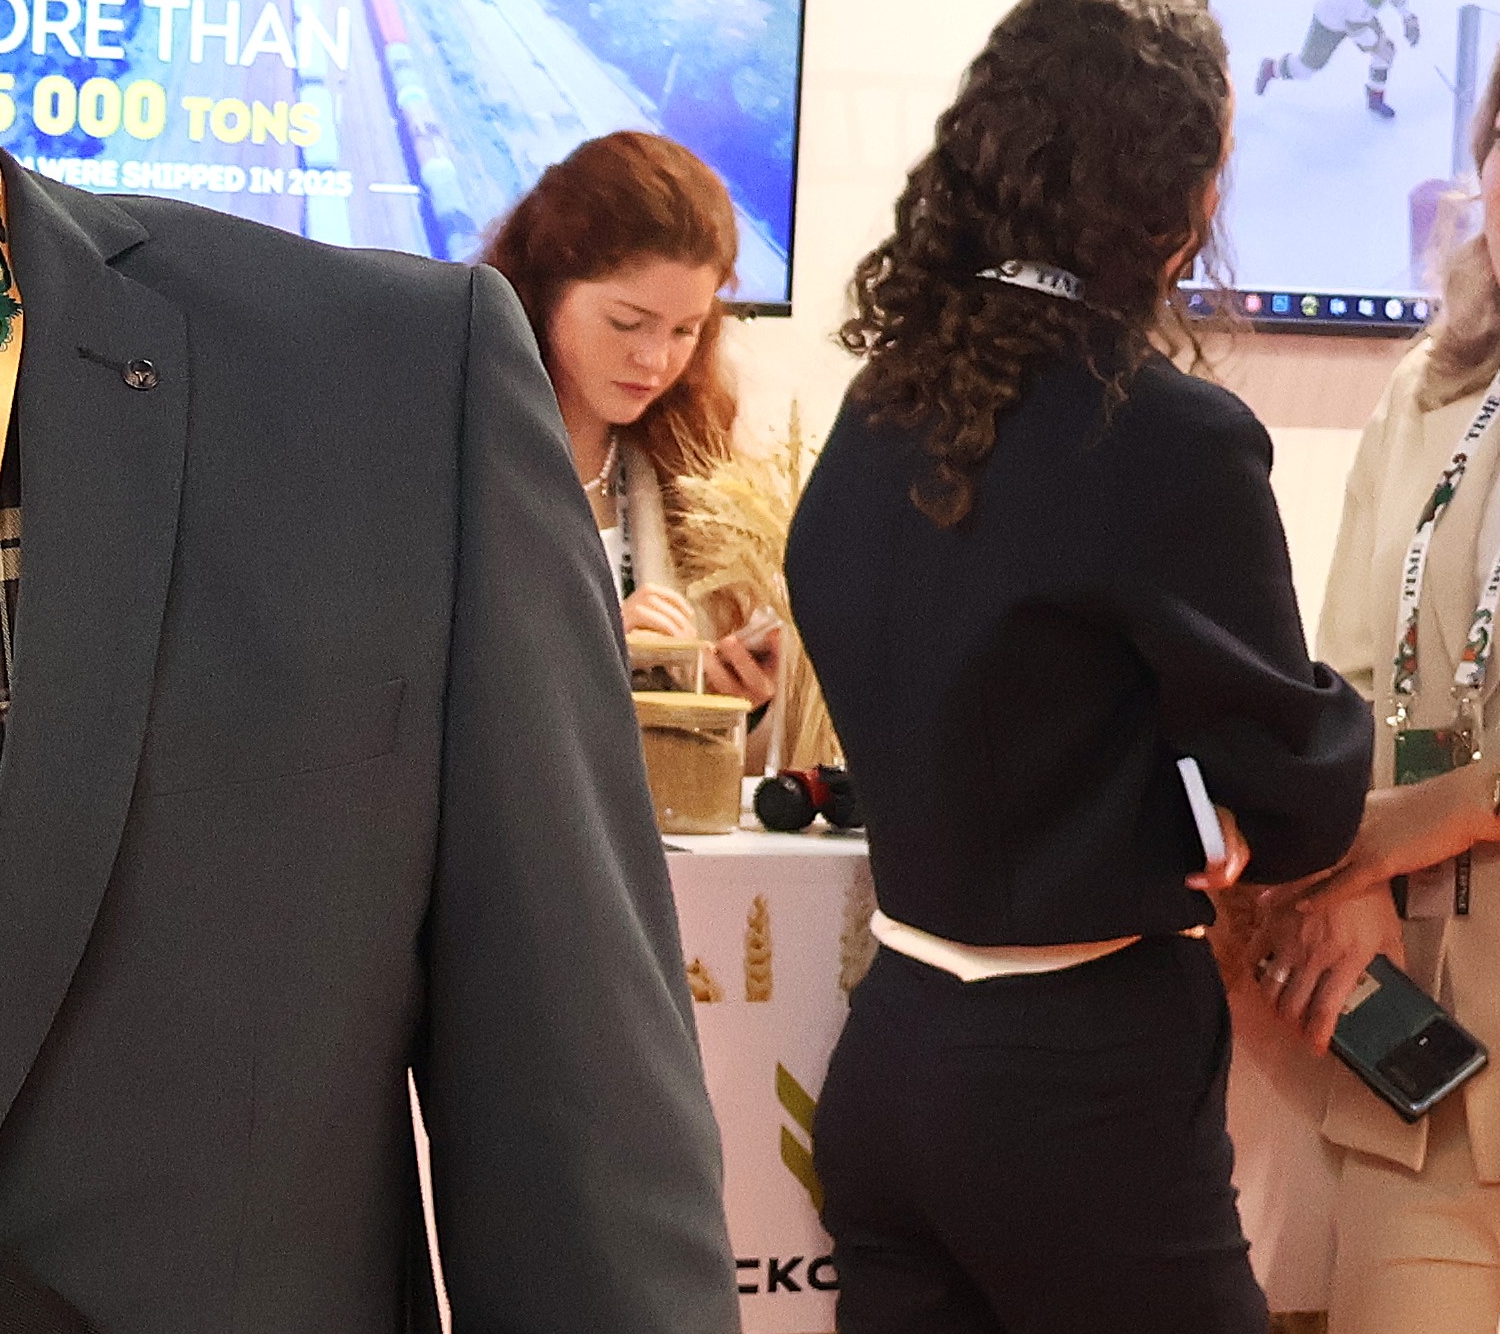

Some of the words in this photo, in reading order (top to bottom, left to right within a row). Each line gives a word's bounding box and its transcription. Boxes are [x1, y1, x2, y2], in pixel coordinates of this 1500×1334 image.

[31, 73, 169, 144] 000
[182, 97, 322, 151] TONS
[37, 155, 119, 187] WERE
[121, 160, 246, 195] SHIPPED
[248, 166, 286, 197] IN
[286, 168, 355, 198] 2025
